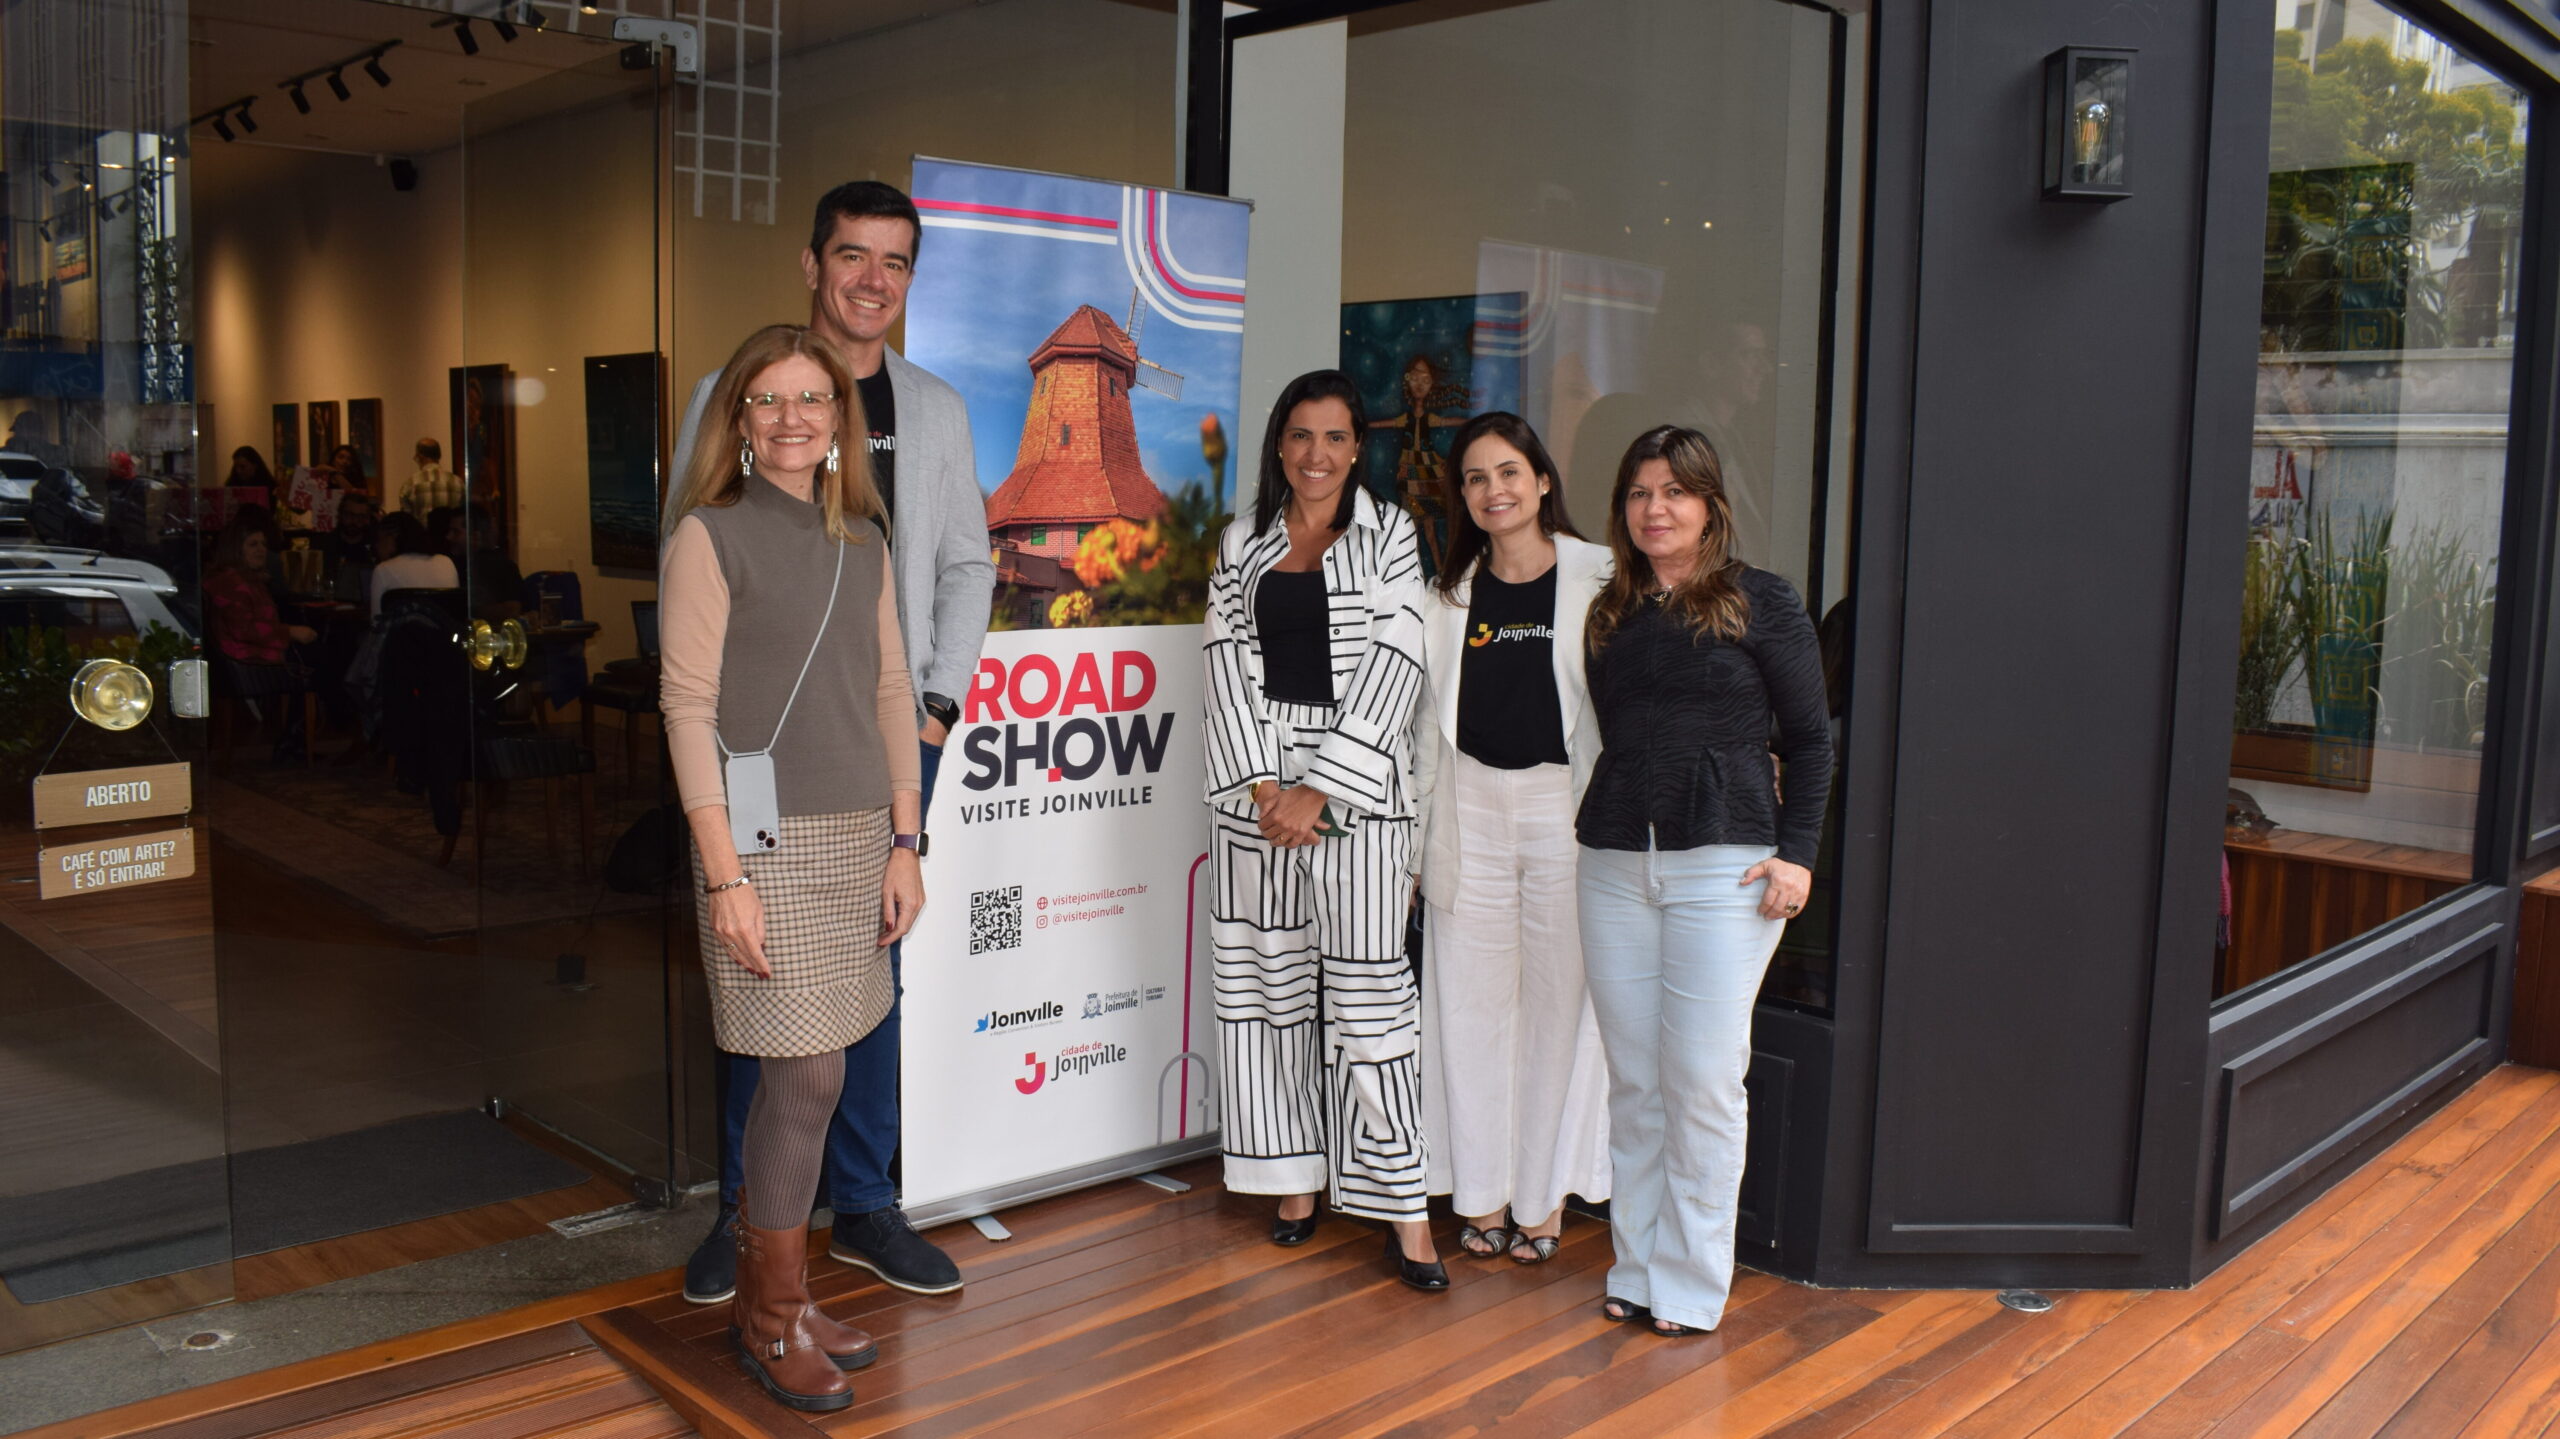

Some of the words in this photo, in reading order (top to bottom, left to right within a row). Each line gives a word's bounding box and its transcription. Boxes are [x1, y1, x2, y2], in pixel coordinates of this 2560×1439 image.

[865, 435, 896, 453] nvill
[1493, 625, 1554, 643] Joinville
[964, 650, 1157, 724] ROAD
[961, 711, 1176, 791] SHOW
[85, 780, 151, 808] ABERTO
[960, 797, 1030, 825] VISITE
[1040, 785, 1153, 815] JOINVILLE
[61, 850, 95, 873] CAFÉ
[99, 847, 130, 867] COM
[135, 840, 176, 861] ARTE?
[74, 870, 83, 889] É
[87, 865, 105, 888] SÓ
[110, 860, 166, 884] ENTRAR!
[1052, 883, 1148, 906] visitejoinville.com.br
[1052, 904, 1125, 926] @visitejoinville
[1104, 997, 1138, 1013] Joinville
[1105, 991, 1130, 1001] Prefeitura
[1131, 989, 1138, 997] de
[990, 1001, 1064, 1030] Joinville
[1050, 1043, 1127, 1082] Joinville
[1061, 1042, 1090, 1057] cidade
[1092, 1040, 1103, 1050] de
